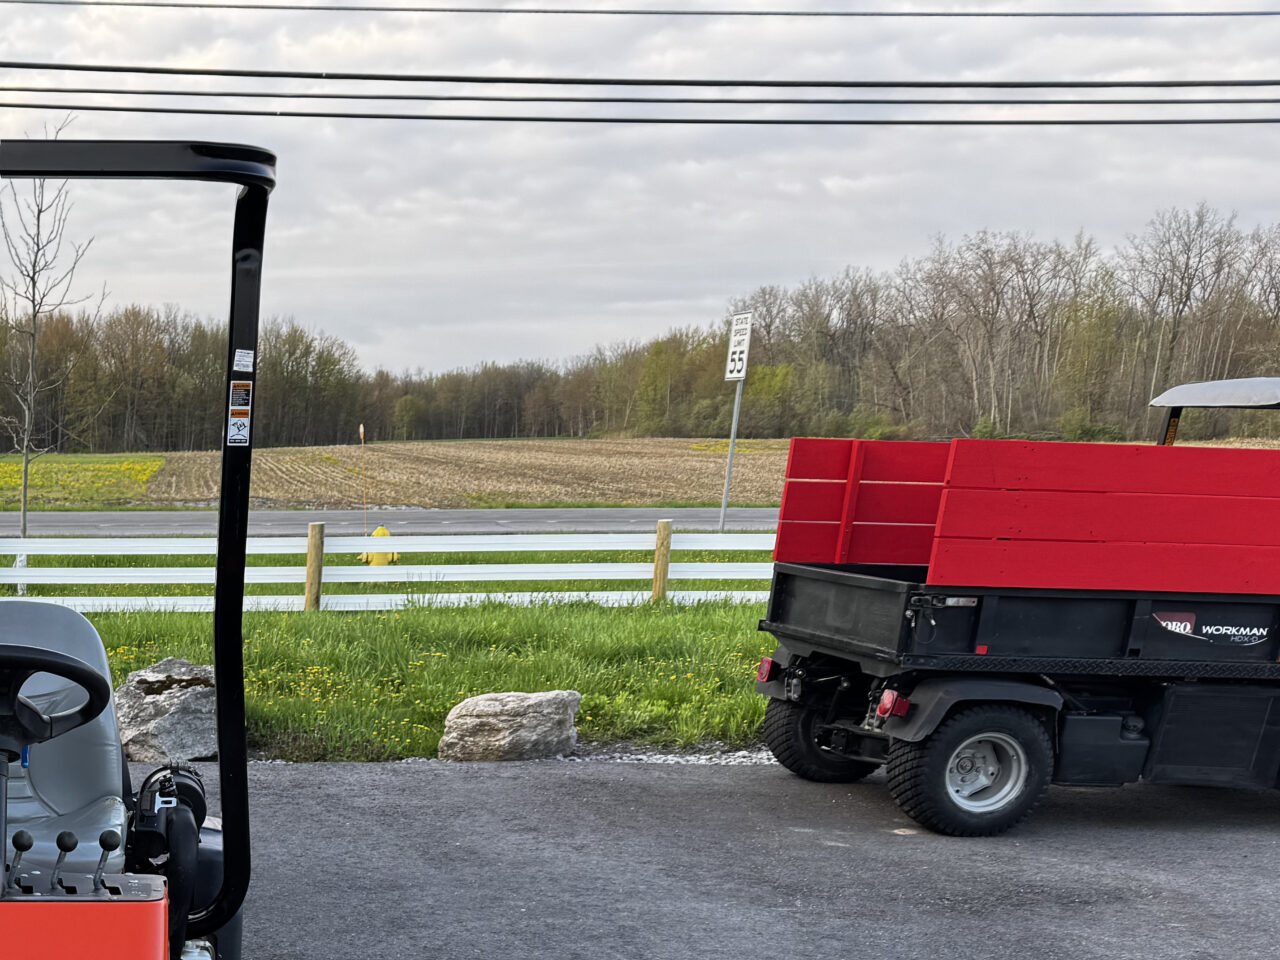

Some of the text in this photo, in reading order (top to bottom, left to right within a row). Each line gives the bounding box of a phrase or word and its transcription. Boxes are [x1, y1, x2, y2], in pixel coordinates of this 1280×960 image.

[735, 316, 749, 326] STATE
[733, 328, 748, 337] SPEED
[729, 350, 745, 374] 55
[1202, 625, 1268, 636] WORKMAN
